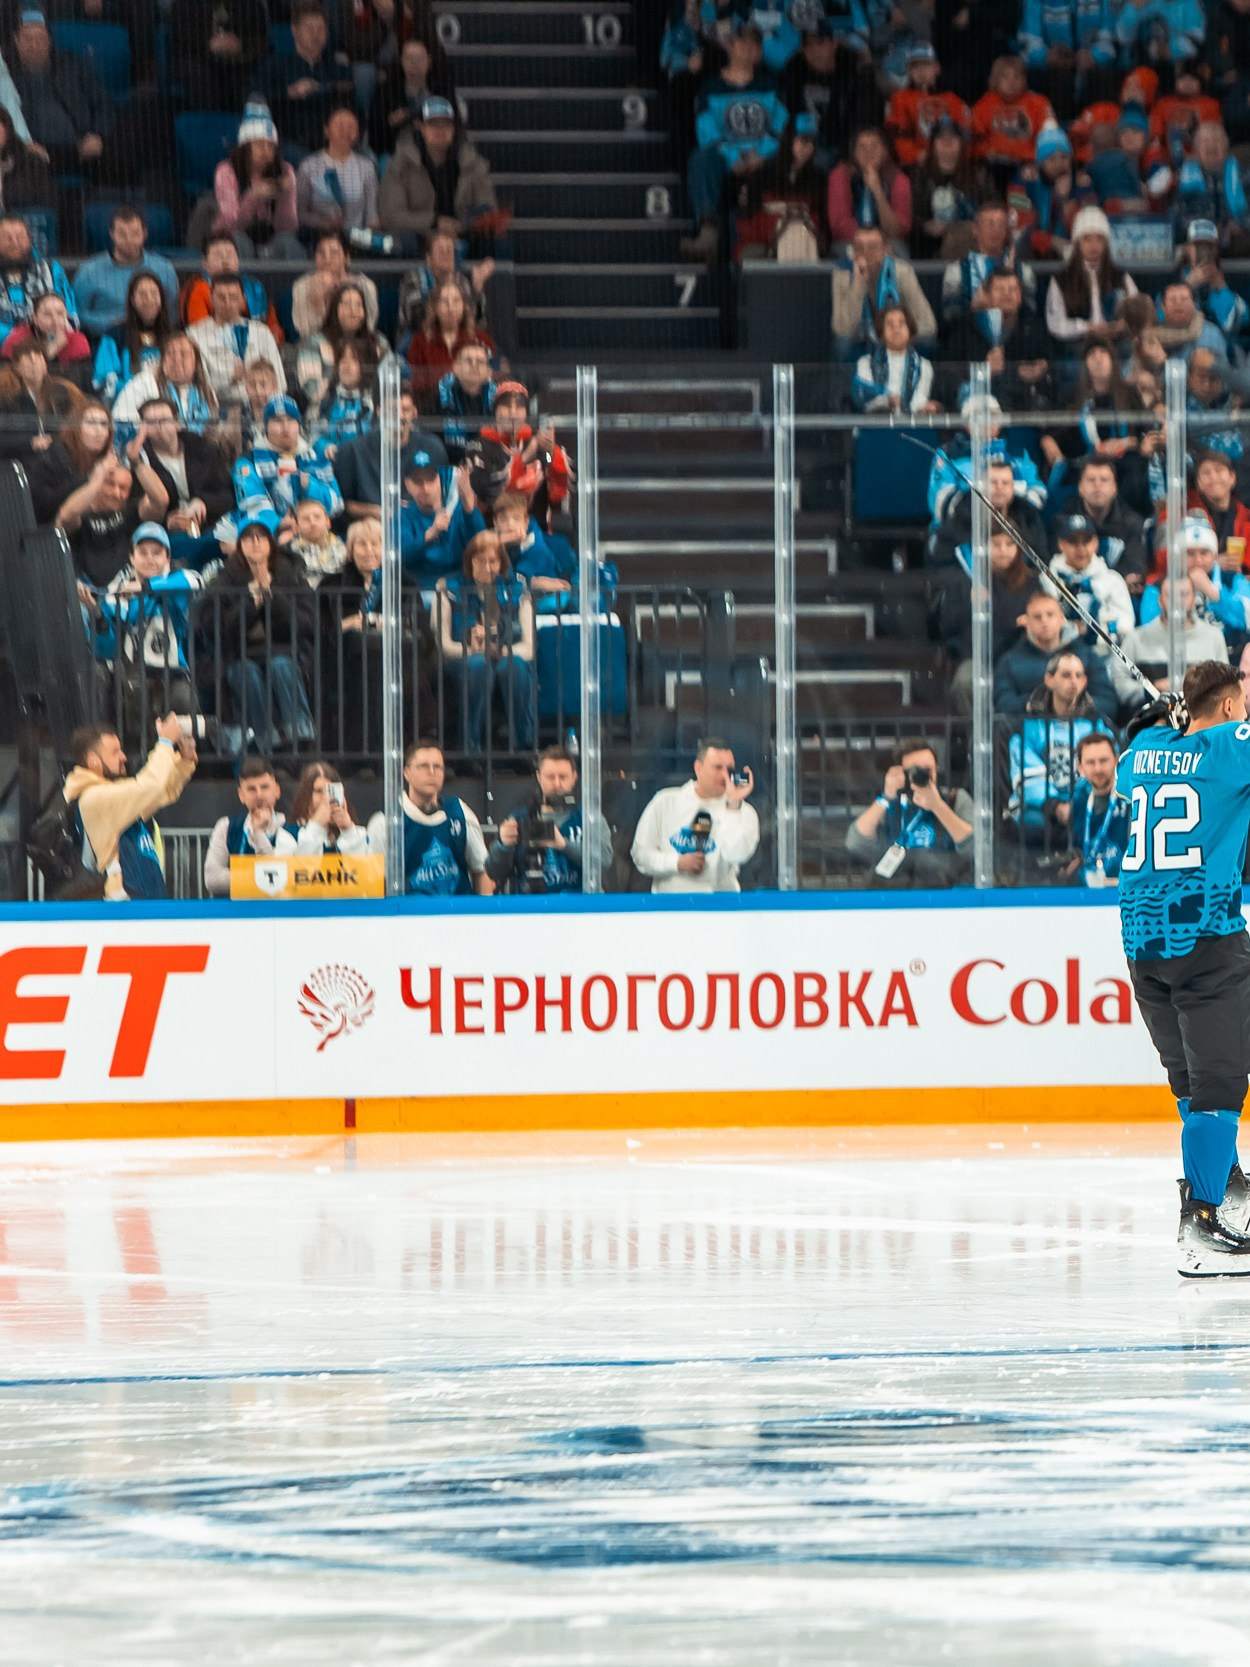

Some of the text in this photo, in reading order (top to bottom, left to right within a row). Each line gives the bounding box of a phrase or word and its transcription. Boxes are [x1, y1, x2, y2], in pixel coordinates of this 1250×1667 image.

[582, 13, 622, 47] 10
[622, 93, 648, 128] 9
[646, 185, 671, 218] 8
[674, 271, 697, 308] 7
[949, 956, 1133, 1027] Cola
[0, 944, 210, 1080] ET
